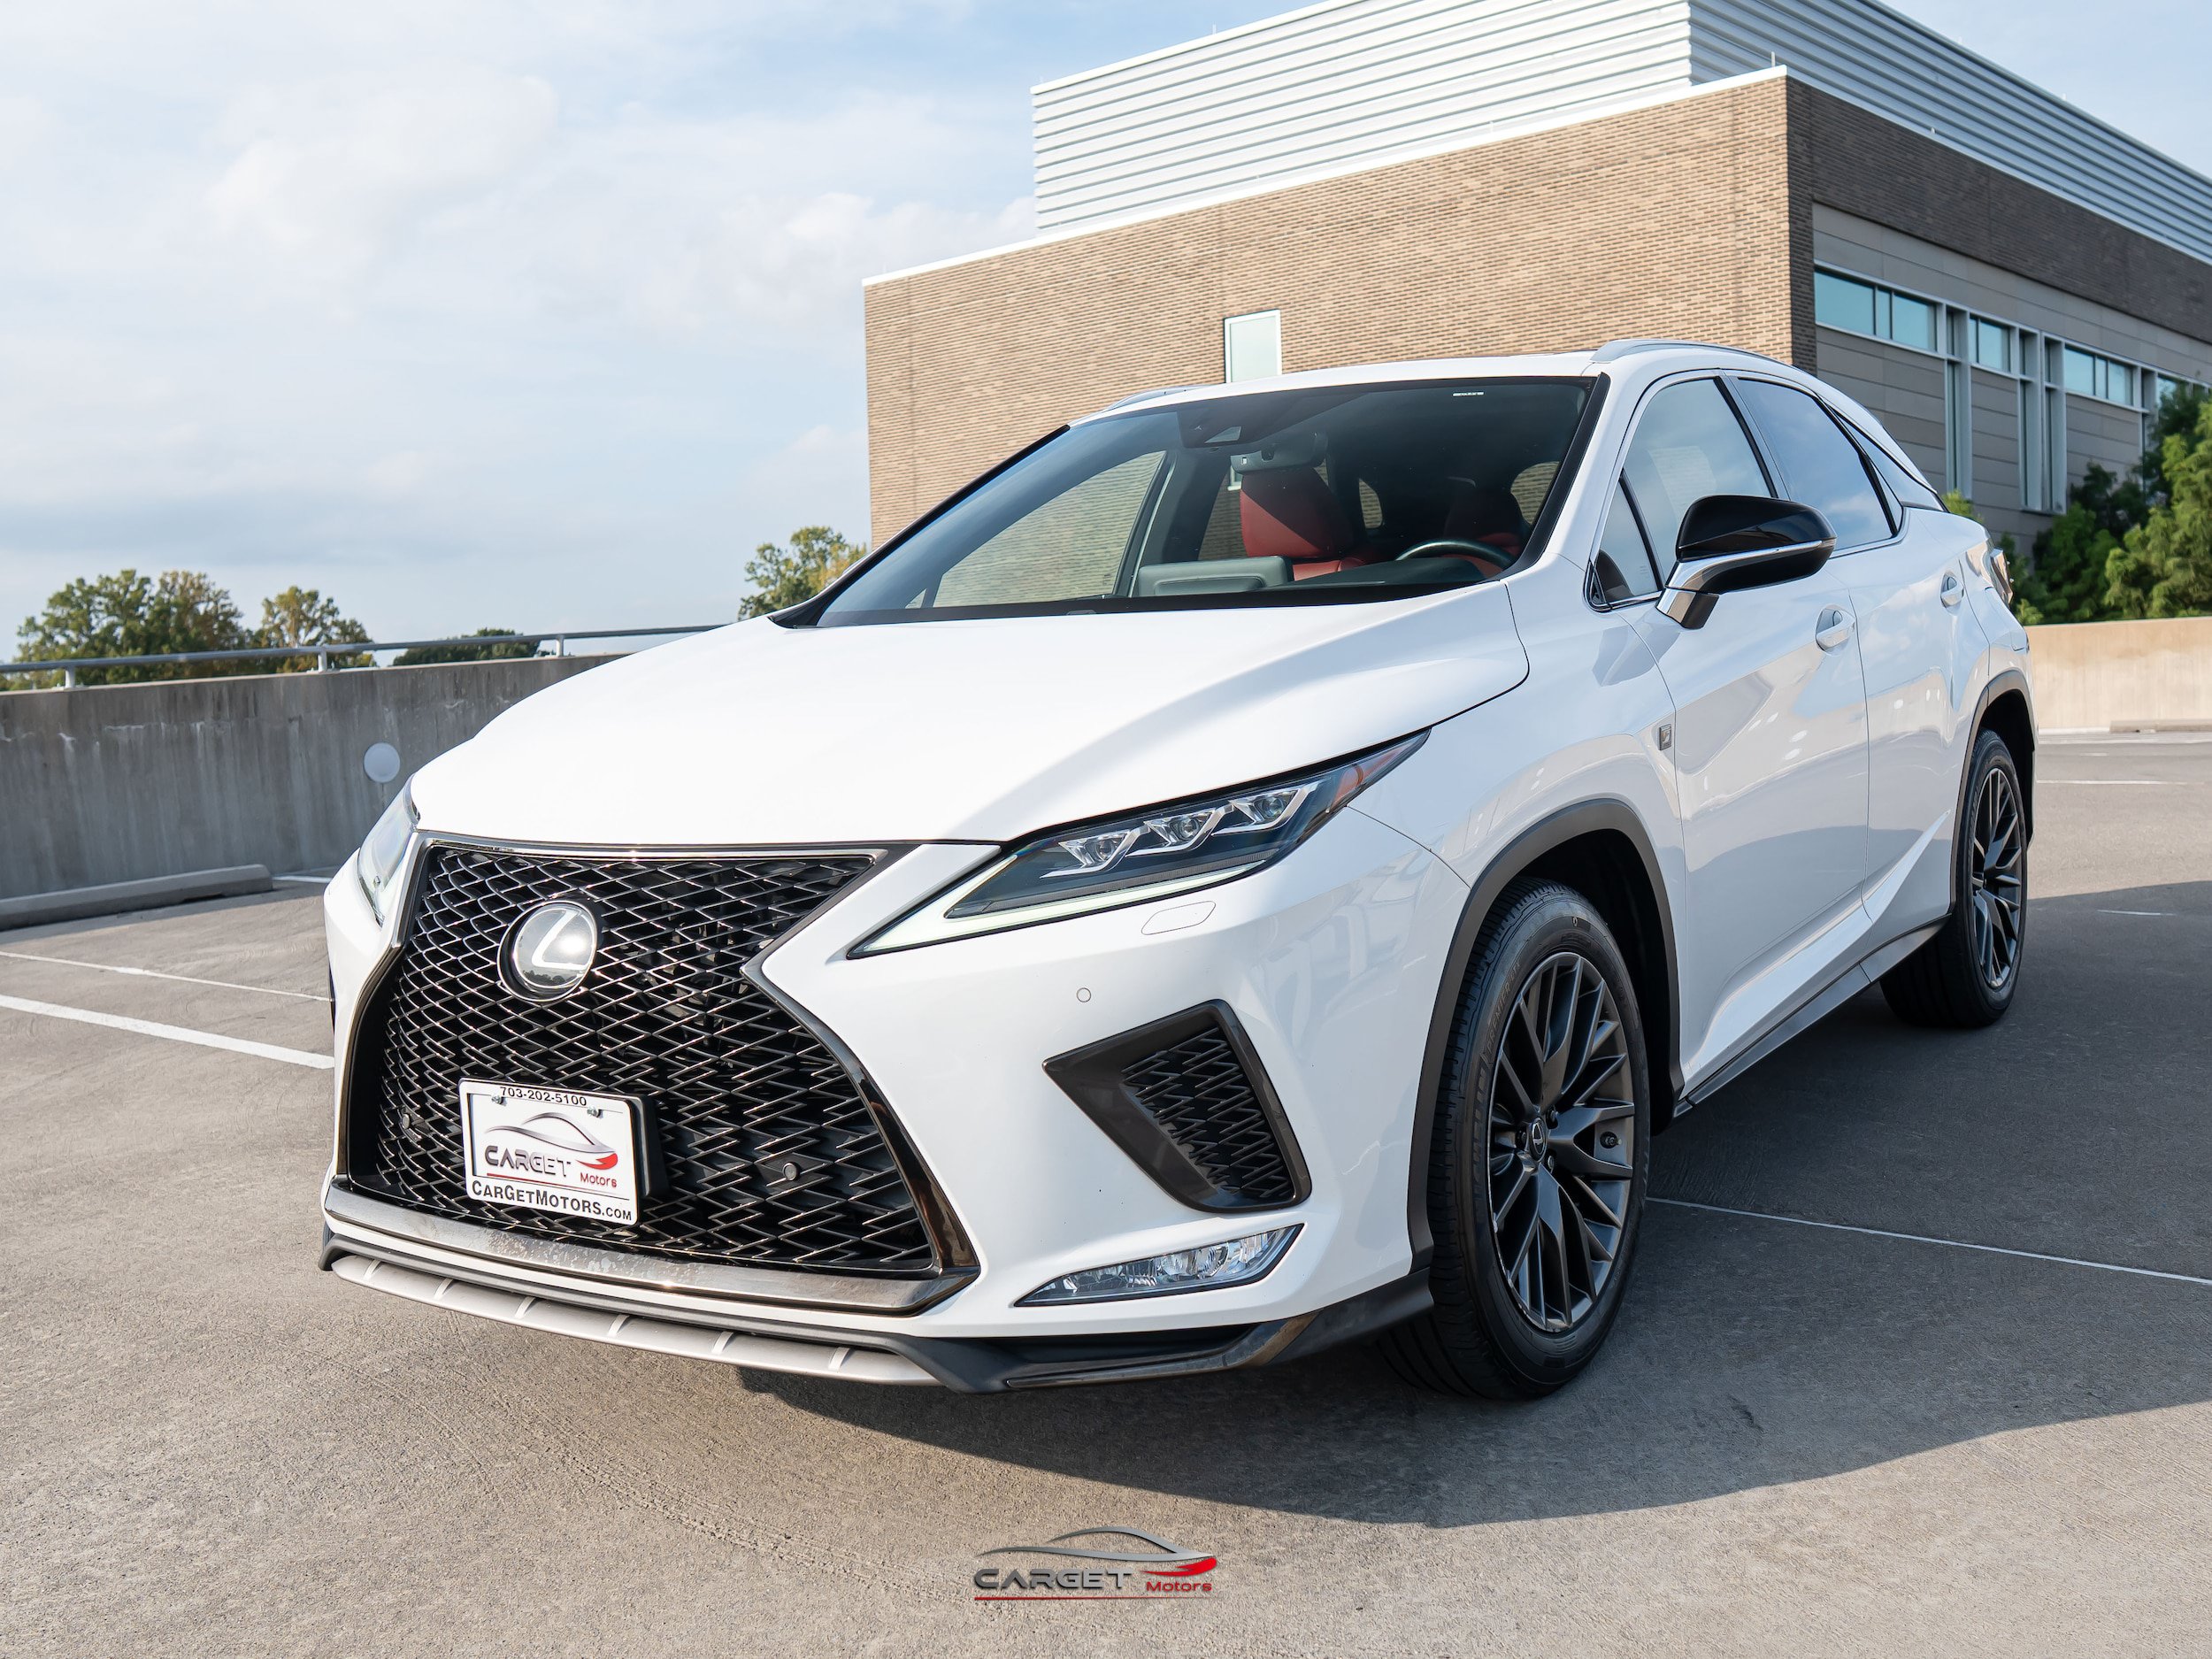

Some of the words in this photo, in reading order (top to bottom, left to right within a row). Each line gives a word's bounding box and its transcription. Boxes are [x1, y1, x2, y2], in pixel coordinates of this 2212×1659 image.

[499, 1086, 588, 1107] 703-202-5100
[484, 1145, 572, 1178] CARGET
[580, 1172, 618, 1188] Motors
